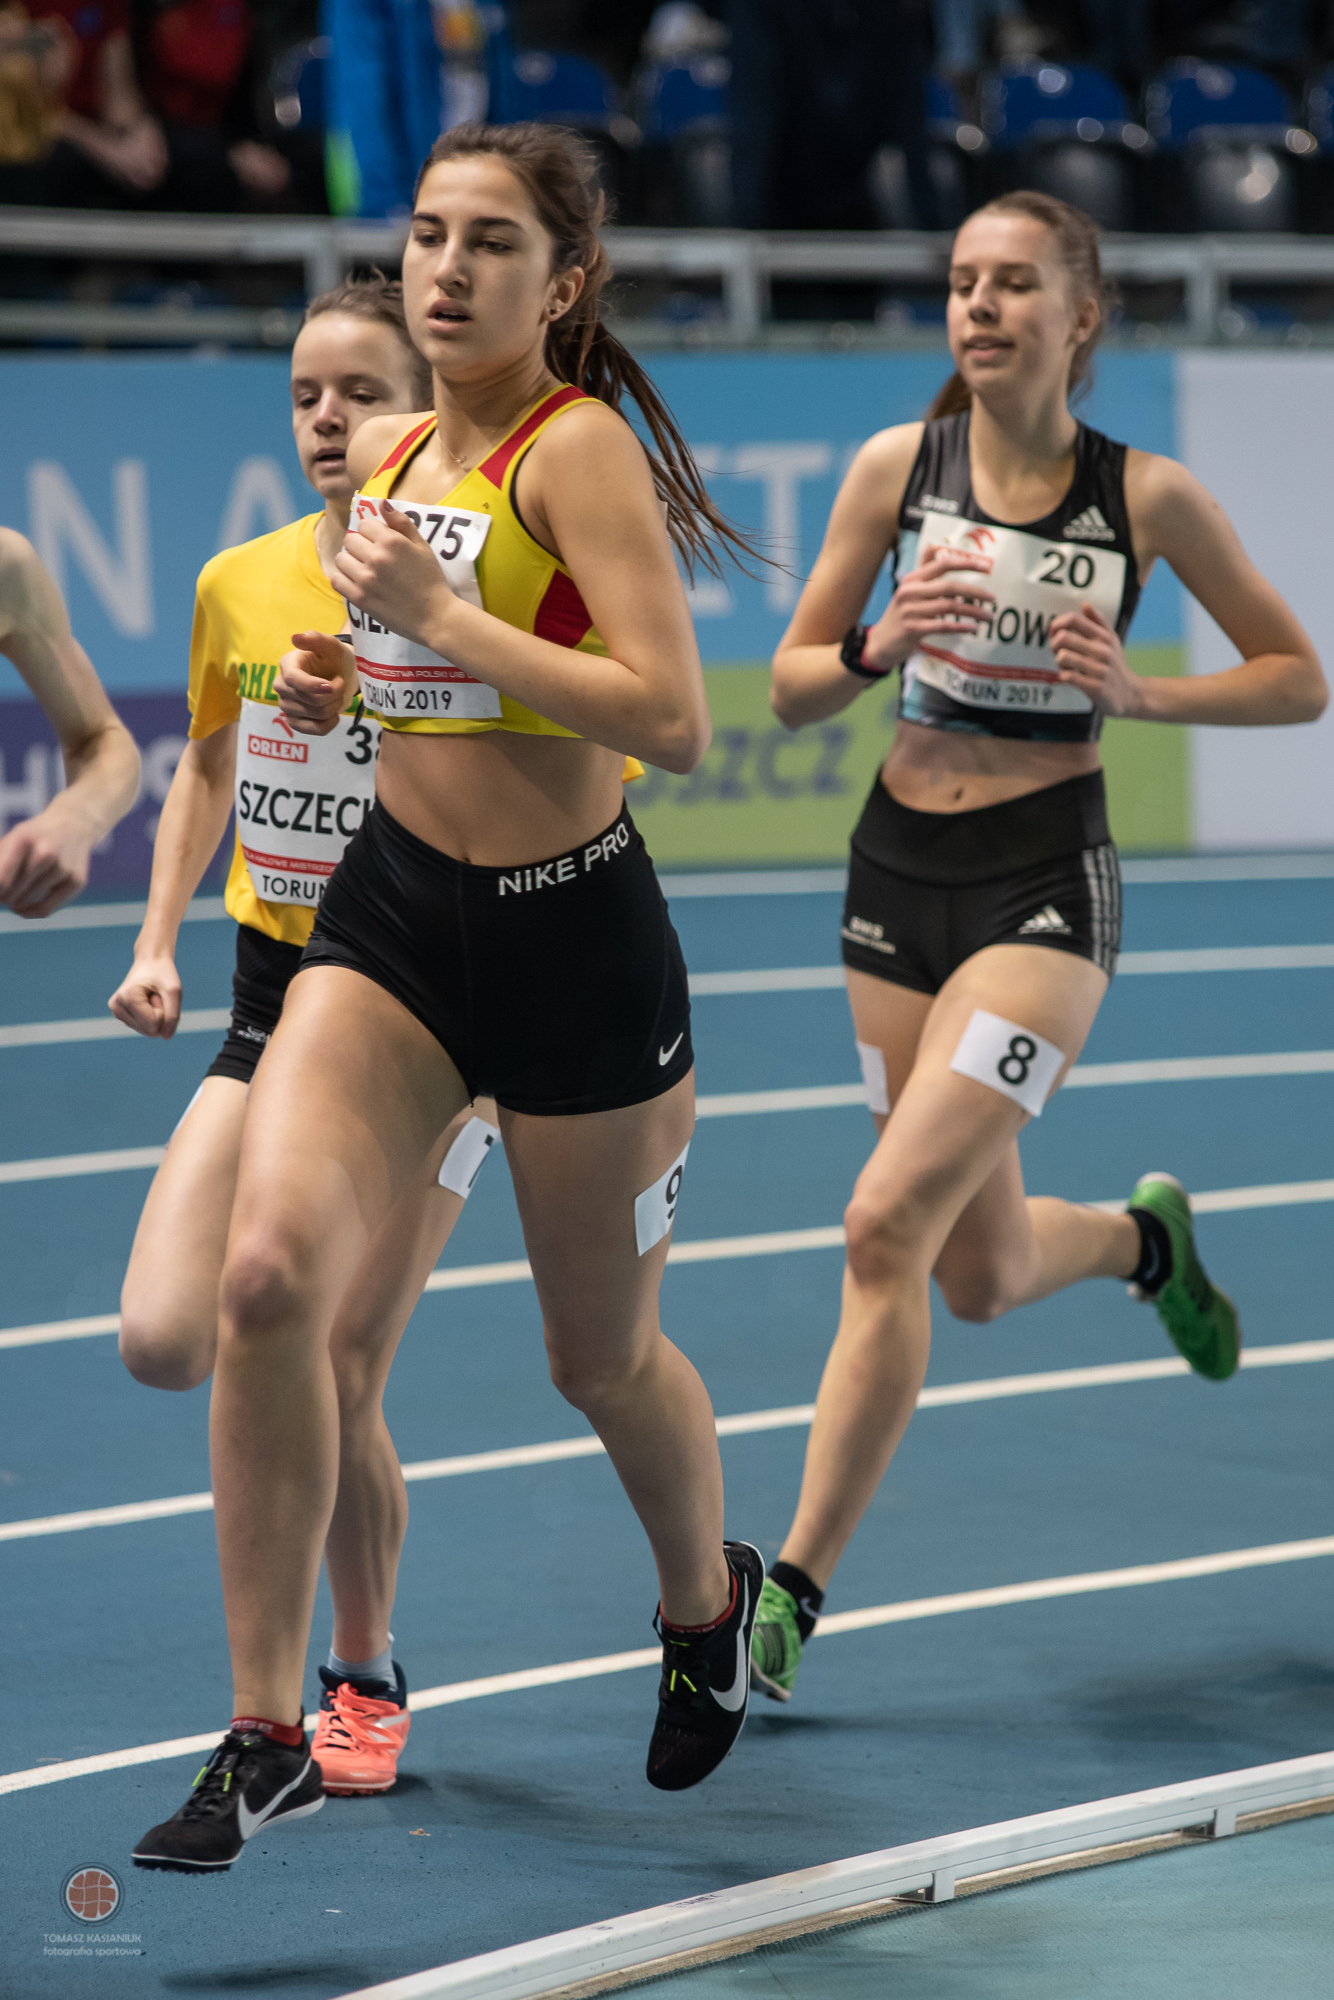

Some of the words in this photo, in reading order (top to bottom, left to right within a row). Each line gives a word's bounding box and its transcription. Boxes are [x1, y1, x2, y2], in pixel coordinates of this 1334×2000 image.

[1040, 550, 1095, 588] 20
[364, 681, 397, 709] TORUŃ
[403, 689, 452, 711] 2019
[1006, 684, 1054, 705] 2019
[249, 736, 305, 761] ORLEN
[345, 724, 383, 765] 3
[498, 857, 577, 896] NIKE
[584, 822, 629, 872] PRO
[997, 1035, 1038, 1086] 8
